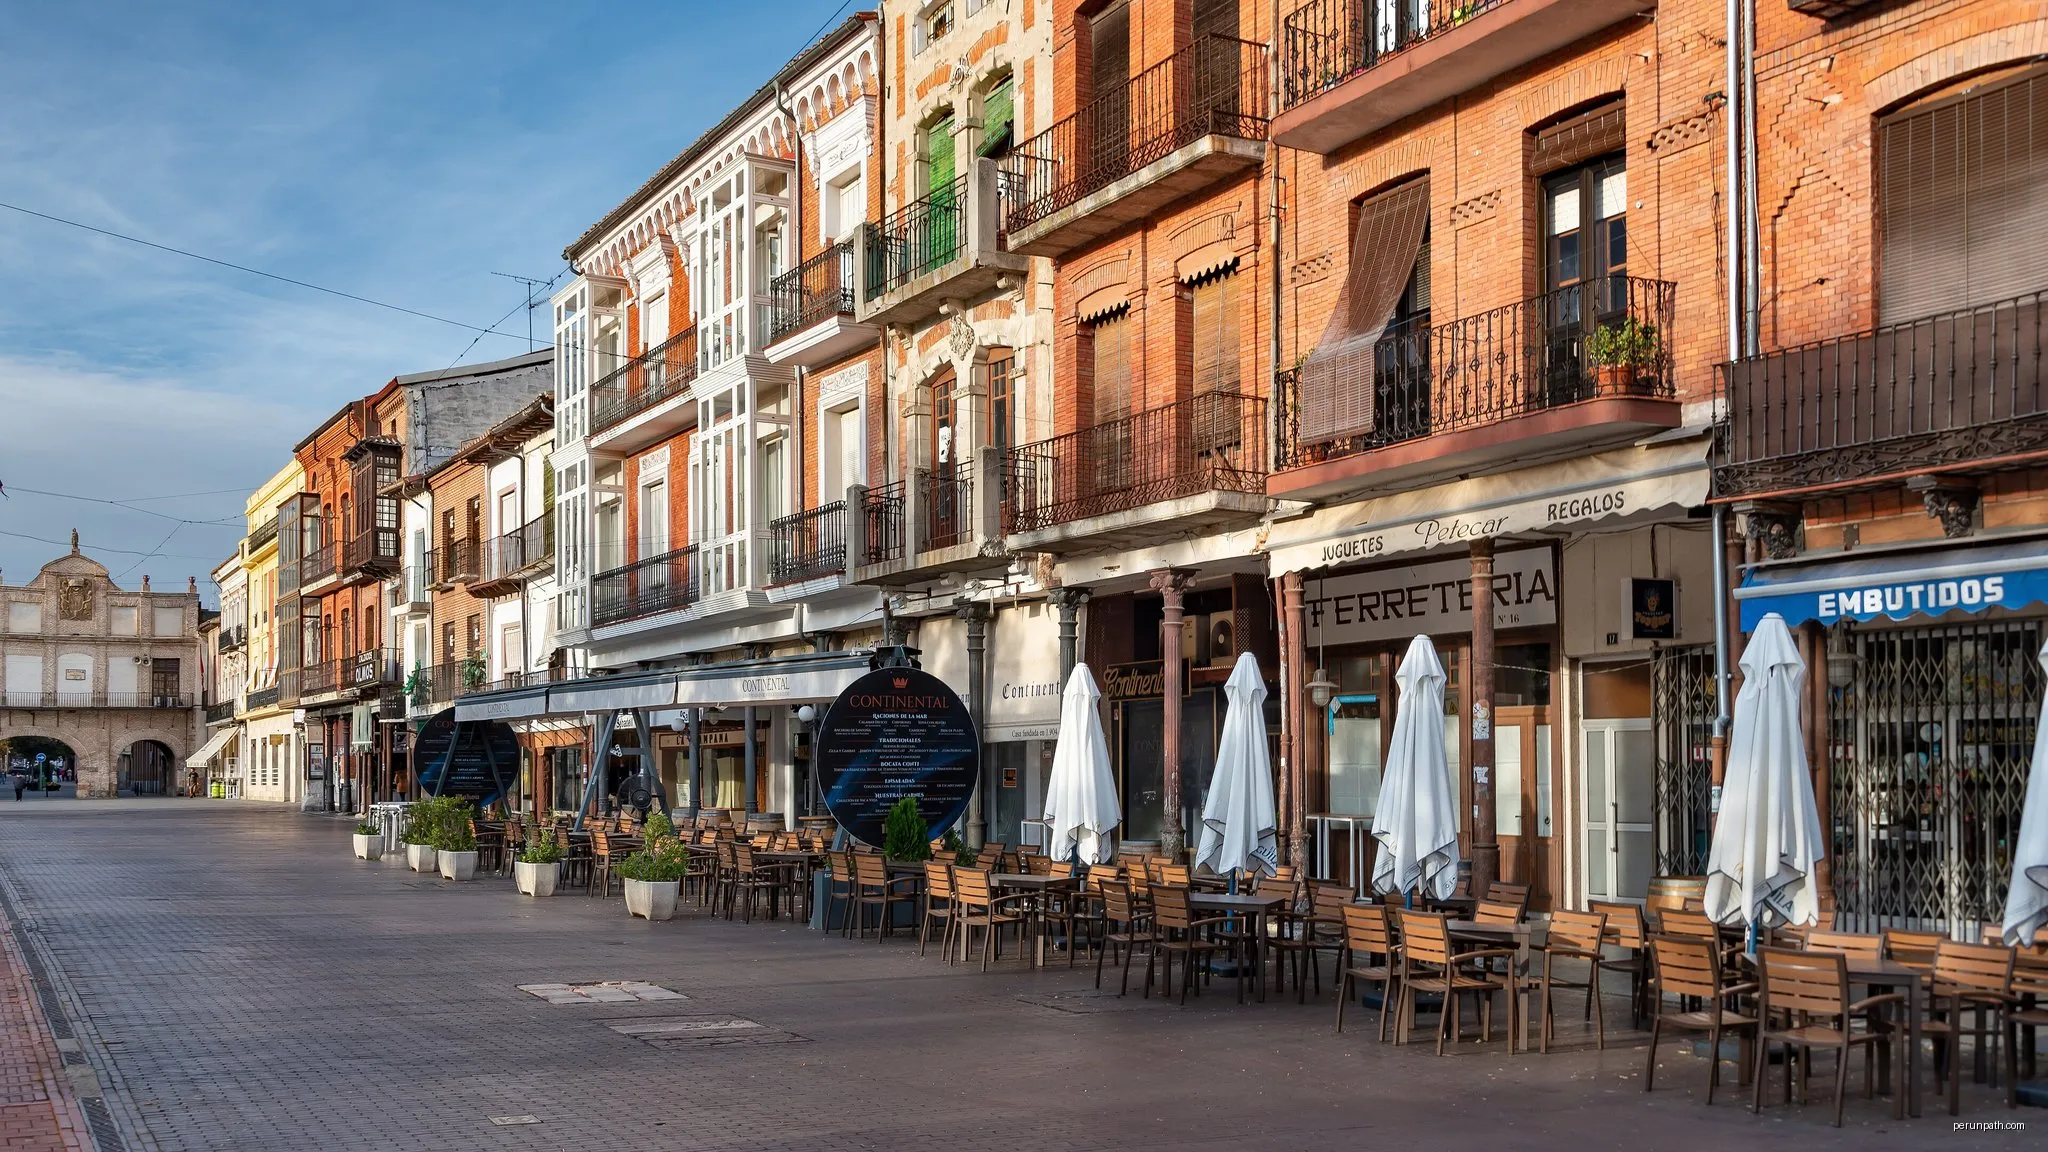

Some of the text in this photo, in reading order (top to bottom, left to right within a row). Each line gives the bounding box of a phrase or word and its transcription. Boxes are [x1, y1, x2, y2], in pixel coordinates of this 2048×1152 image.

[1322, 491, 1625, 562] JUGUETES Petecar REGALOS
[1305, 569, 1555, 627] FERRETERIA
[1818, 576, 2004, 617] EMBUTIDOS
[1510, 614, 1520, 623] 16
[742, 677, 790, 692] CONTINENTAL
[1002, 680, 1060, 700] Continent
[1103, 665, 1164, 698] Continent
[850, 694, 949, 709] CONTINENTAL
[676, 733, 729, 745] LA MPANA
